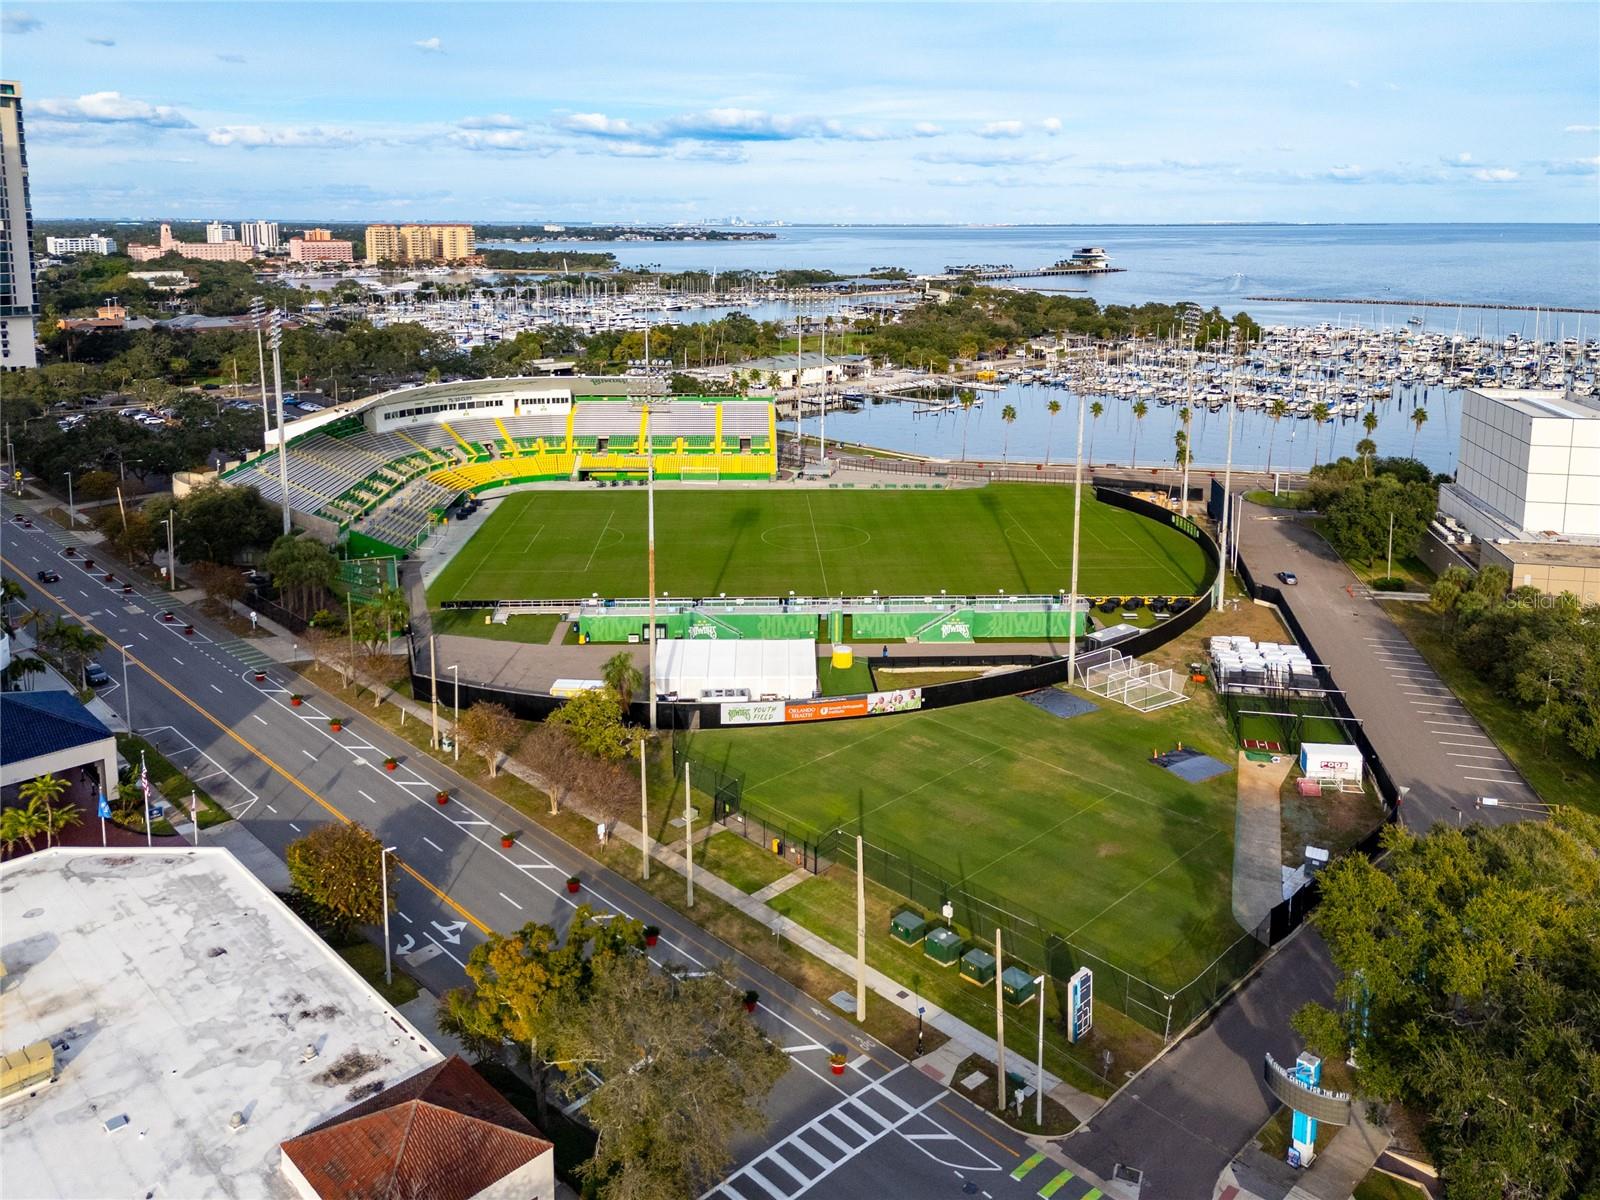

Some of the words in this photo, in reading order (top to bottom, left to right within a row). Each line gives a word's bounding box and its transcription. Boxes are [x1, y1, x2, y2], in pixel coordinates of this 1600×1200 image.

[941, 624, 971, 639] ROWDIES
[753, 705, 777, 714] YOUTH
[752, 713, 774, 721] FIELD
[1321, 761, 1348, 769] PODS
[1289, 1076, 1308, 1089] CENTER
[1309, 1086, 1321, 1095] FOR
[1323, 1089, 1333, 1098] THE
[1336, 1092, 1350, 1101] ARTS
